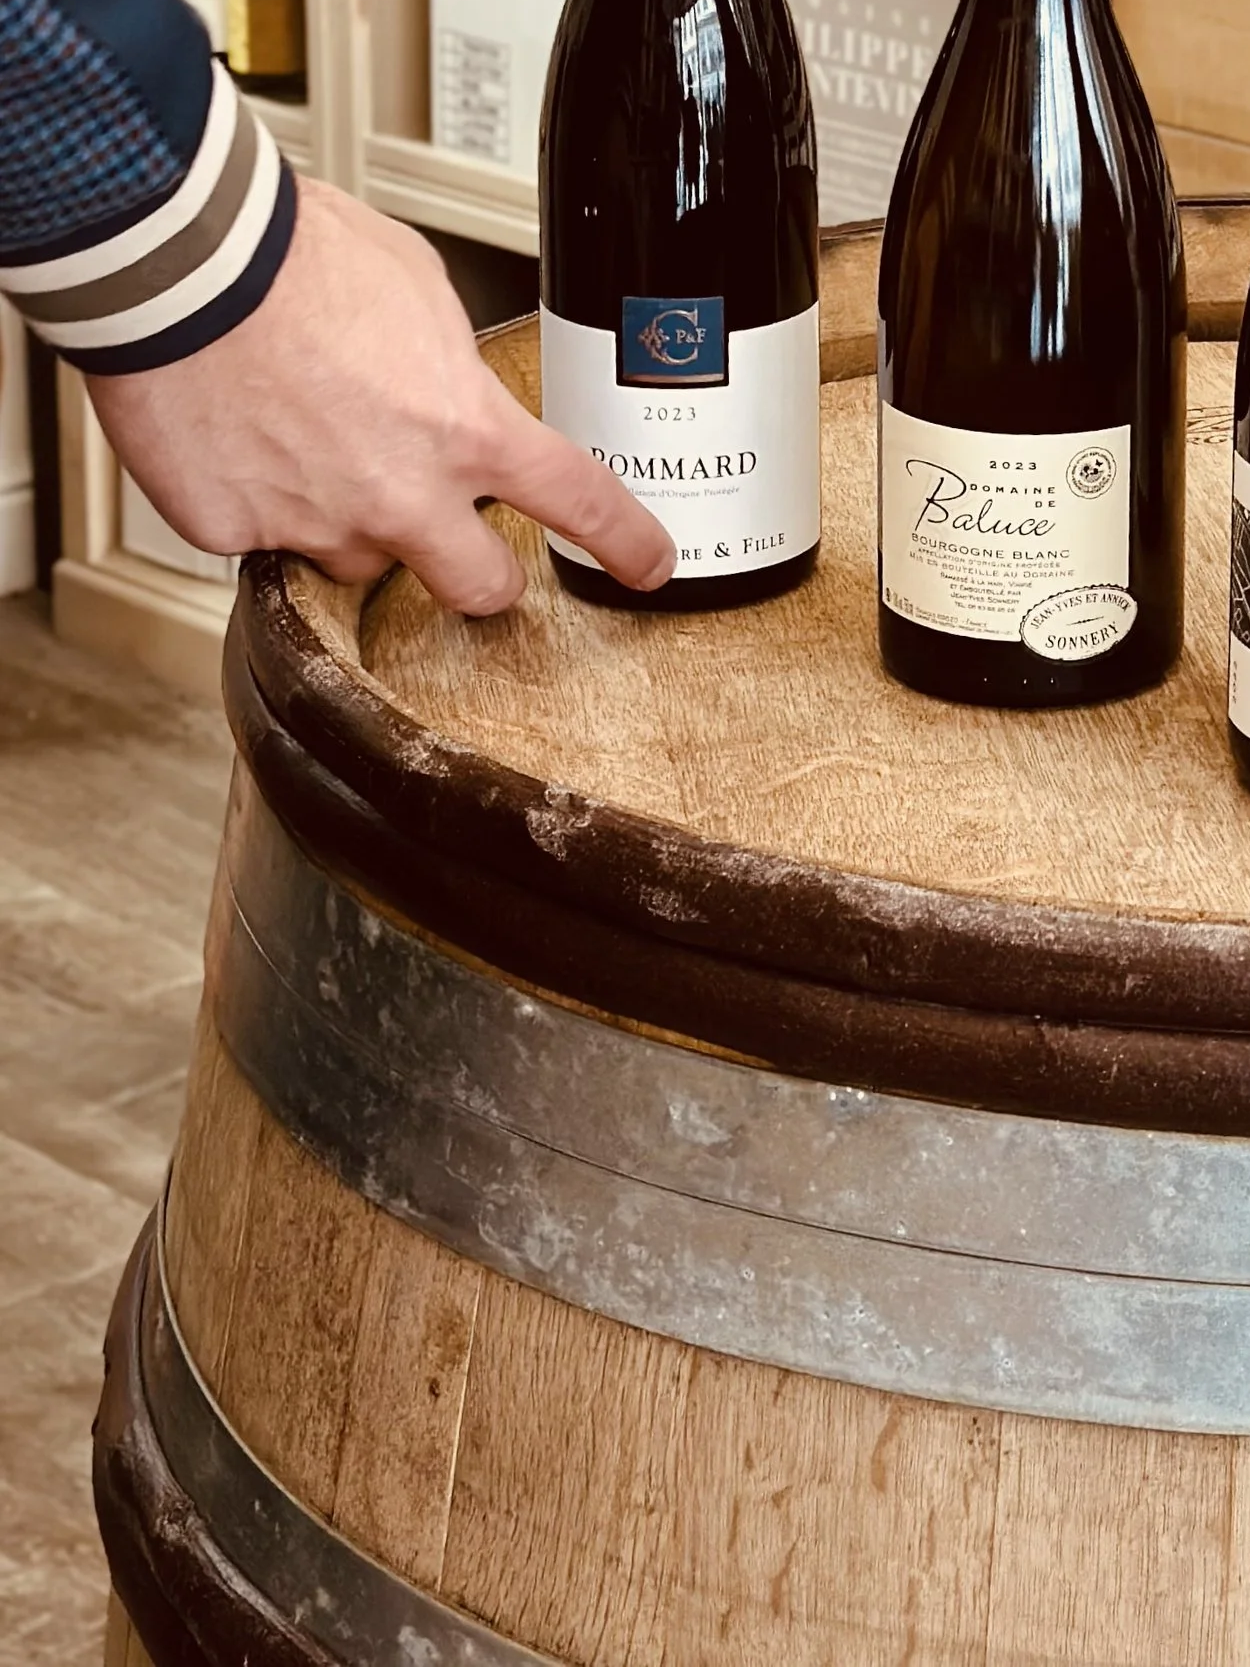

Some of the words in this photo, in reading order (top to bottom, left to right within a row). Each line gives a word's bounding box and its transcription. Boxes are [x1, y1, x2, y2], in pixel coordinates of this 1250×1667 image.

[675, 327, 707, 345] P&F
[642, 405, 698, 422] 2023
[988, 460, 1038, 471] 2023
[904, 458, 1057, 537] Baluce
[969, 482, 1057, 495] DOMAINE
[1034, 499, 1057, 509] DE
[675, 548, 703, 561] RE
[713, 541, 731, 559] &
[910, 532, 1005, 560] BOURGOGNE
[1011, 548, 1071, 560] BLANC
[941, 562, 1000, 578] BOUTEILLE
[1022, 568, 1076, 580] DOMAINE
[1030, 595, 1083, 631] JEAN-YVES
[1085, 593, 1099, 604] ET
[1100, 591, 1132, 614] ANNICK
[1044, 621, 1121, 651] SONNERY
